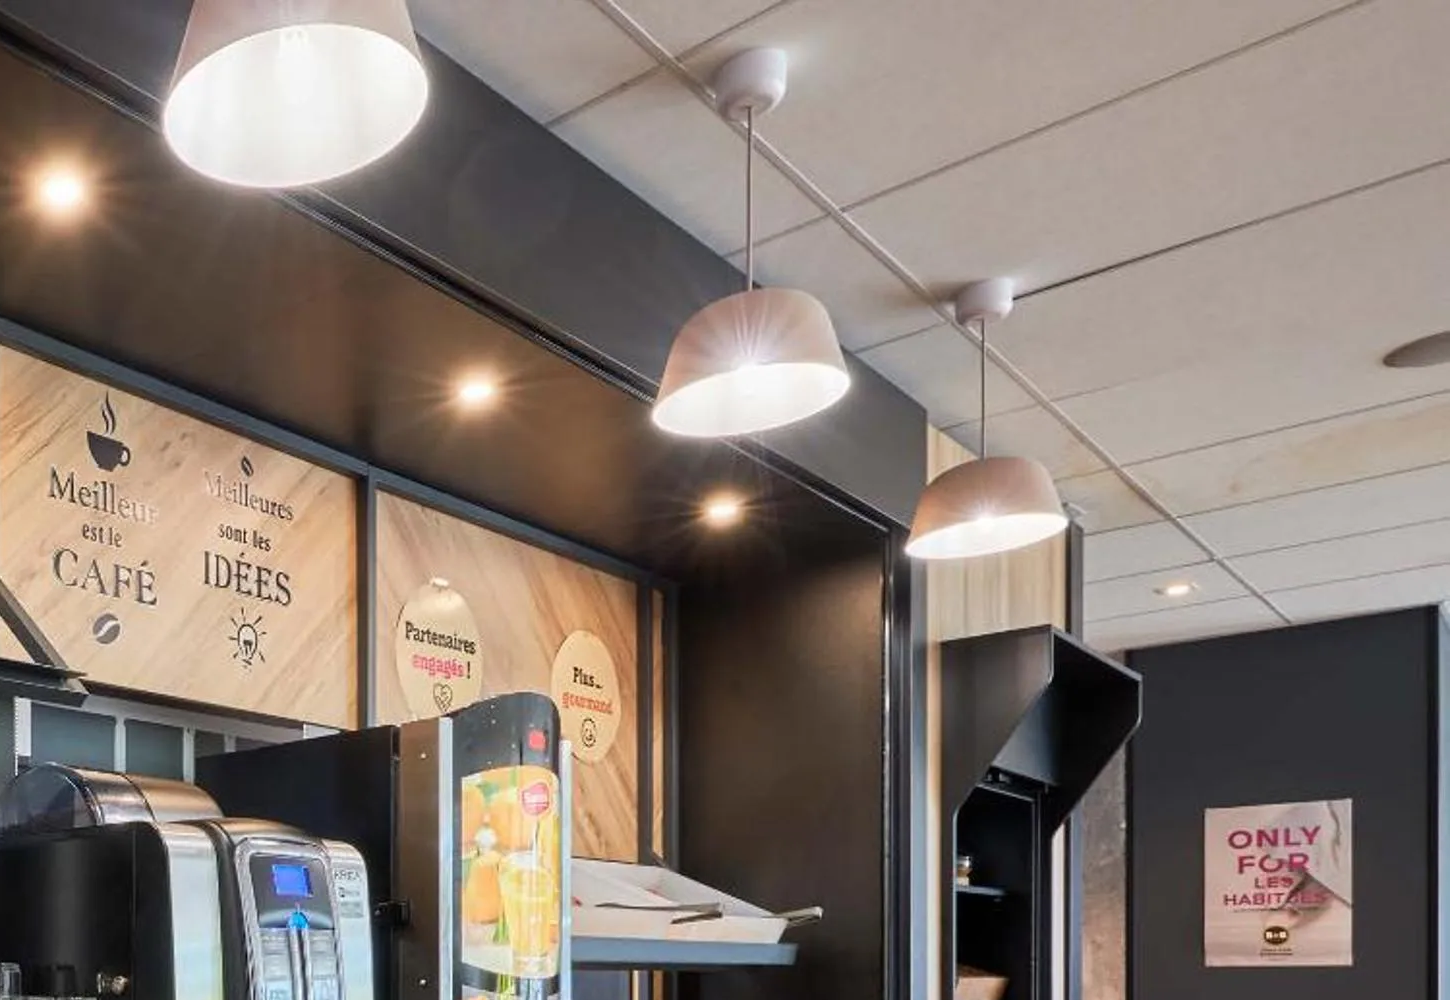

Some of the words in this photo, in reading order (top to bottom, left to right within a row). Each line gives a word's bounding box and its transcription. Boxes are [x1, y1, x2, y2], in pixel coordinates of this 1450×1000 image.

[47, 466, 158, 525] Meilleur
[204, 471, 294, 521] Meilleures
[82, 522, 104, 541] est
[106, 525, 122, 547] le
[218, 522, 248, 544] sont
[252, 530, 272, 552] les
[52, 549, 158, 606] CAFÉ
[202, 550, 292, 607] IDÉES
[405, 621, 476, 655] Partenaires
[1227, 826, 1321, 849] ONLY
[1237, 853, 1310, 875] FOR
